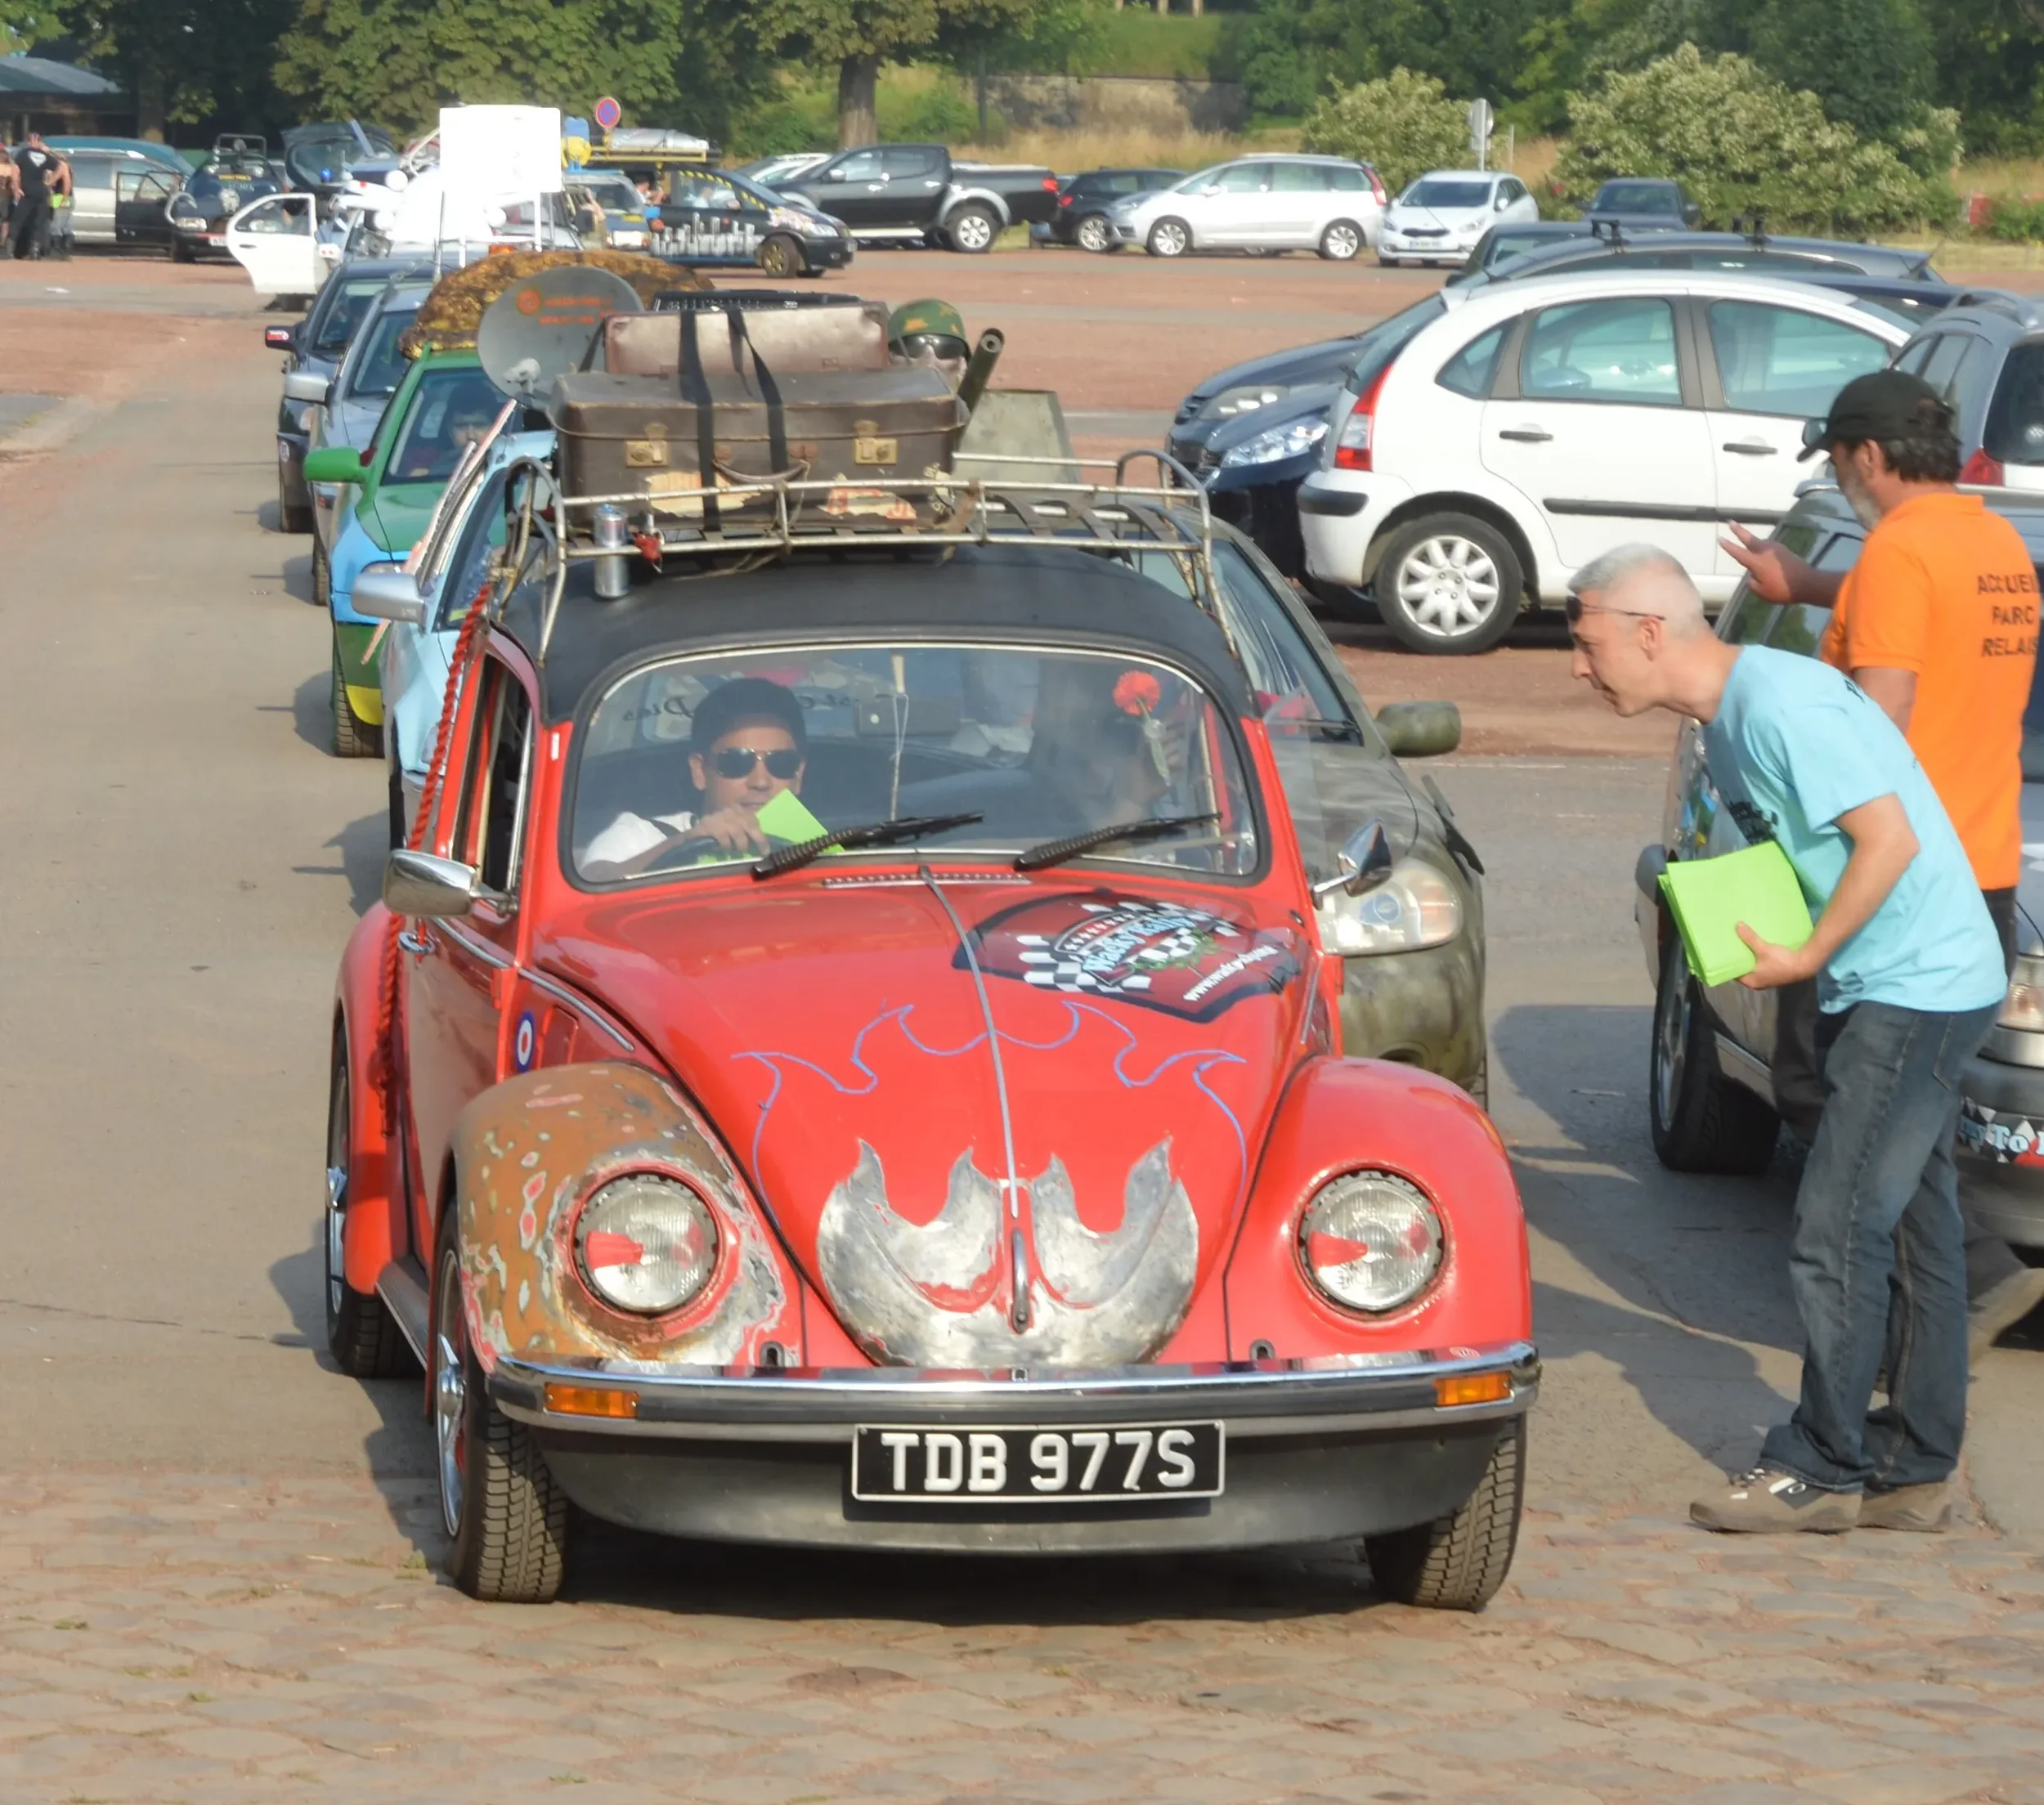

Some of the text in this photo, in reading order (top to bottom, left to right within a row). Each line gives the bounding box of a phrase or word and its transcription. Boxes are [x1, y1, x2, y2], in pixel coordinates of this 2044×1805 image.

[1992, 605, 2035, 625] PARC
[881, 1429, 1196, 1492] TDB 977S
